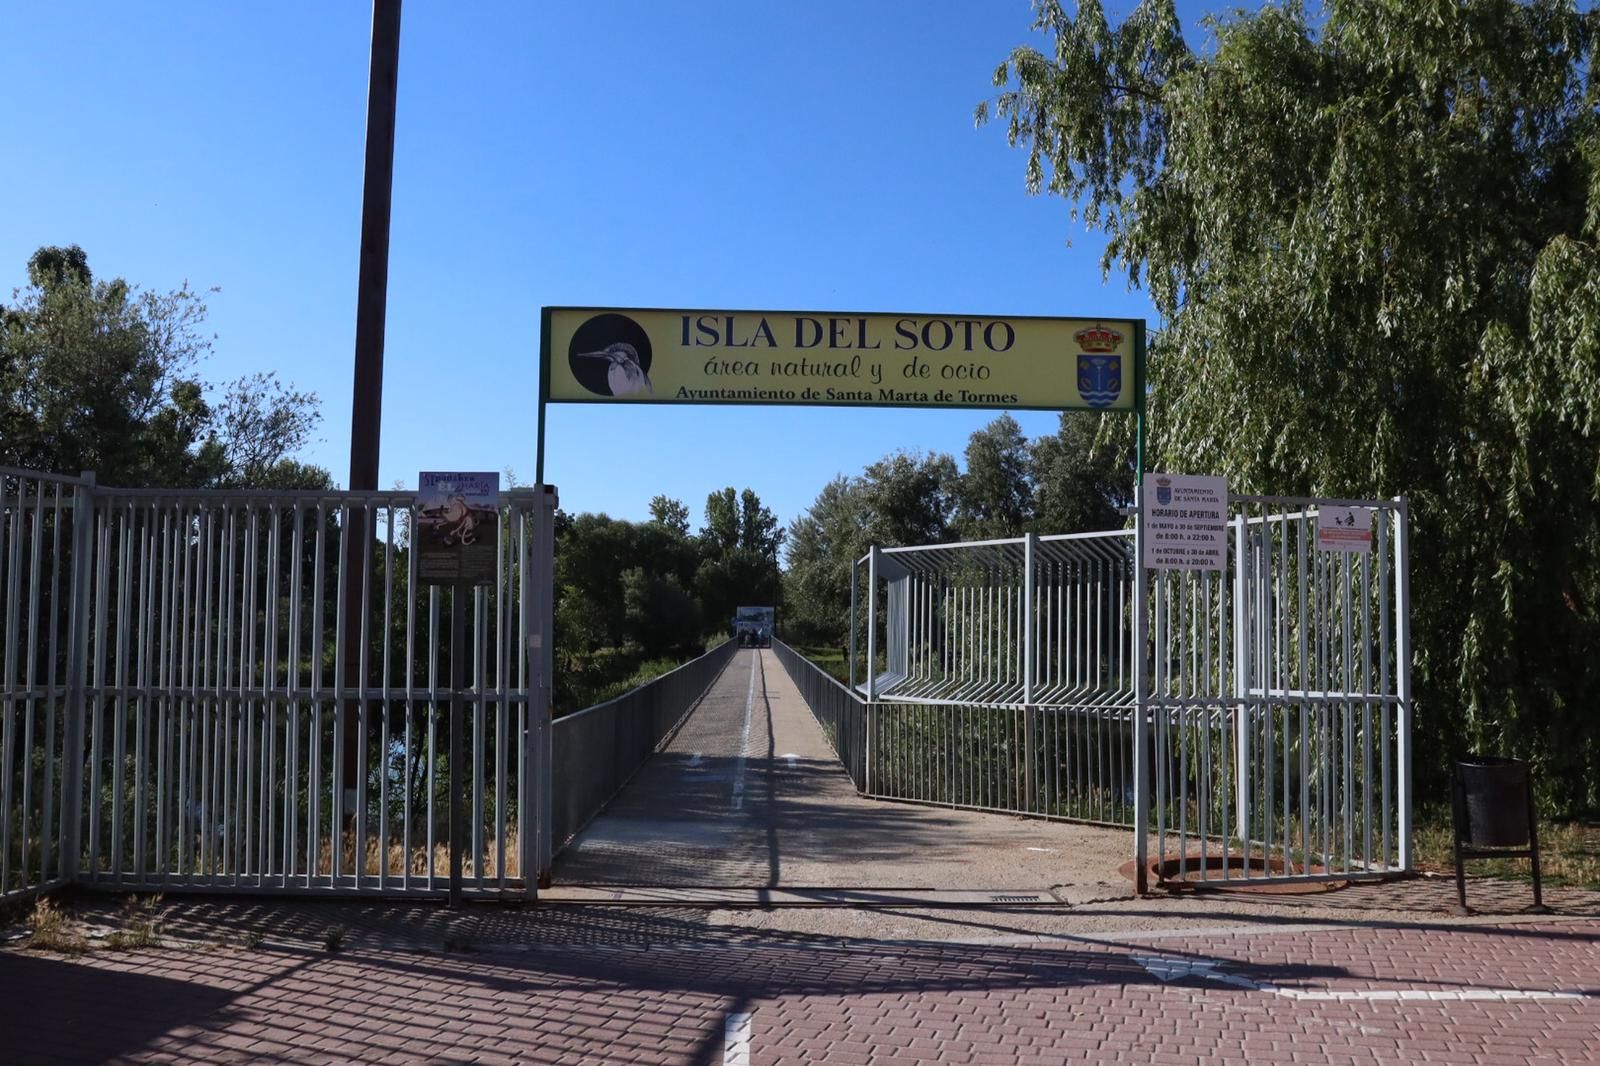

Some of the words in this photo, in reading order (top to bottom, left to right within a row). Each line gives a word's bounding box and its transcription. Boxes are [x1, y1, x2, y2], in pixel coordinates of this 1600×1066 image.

[681, 315, 778, 348] ISLA
[794, 317, 881, 349] DEL
[894, 318, 1015, 352] SOTO
[703, 356, 760, 376] área
[770, 355, 861, 378] natural
[870, 363, 882, 384] y
[903, 356, 931, 379] de
[941, 363, 991, 380] ocio
[675, 385, 796, 401] Ayuntamiento
[801, 386, 821, 400] de
[826, 387, 873, 401] Santa
[879, 388, 929, 402] Marta
[933, 389, 953, 402] de
[958, 389, 1018, 404] Tormes
[1152, 509, 1178, 518] HORARIO
[1179, 509, 1188, 518] DE
[1189, 511, 1220, 519] APERTURA
